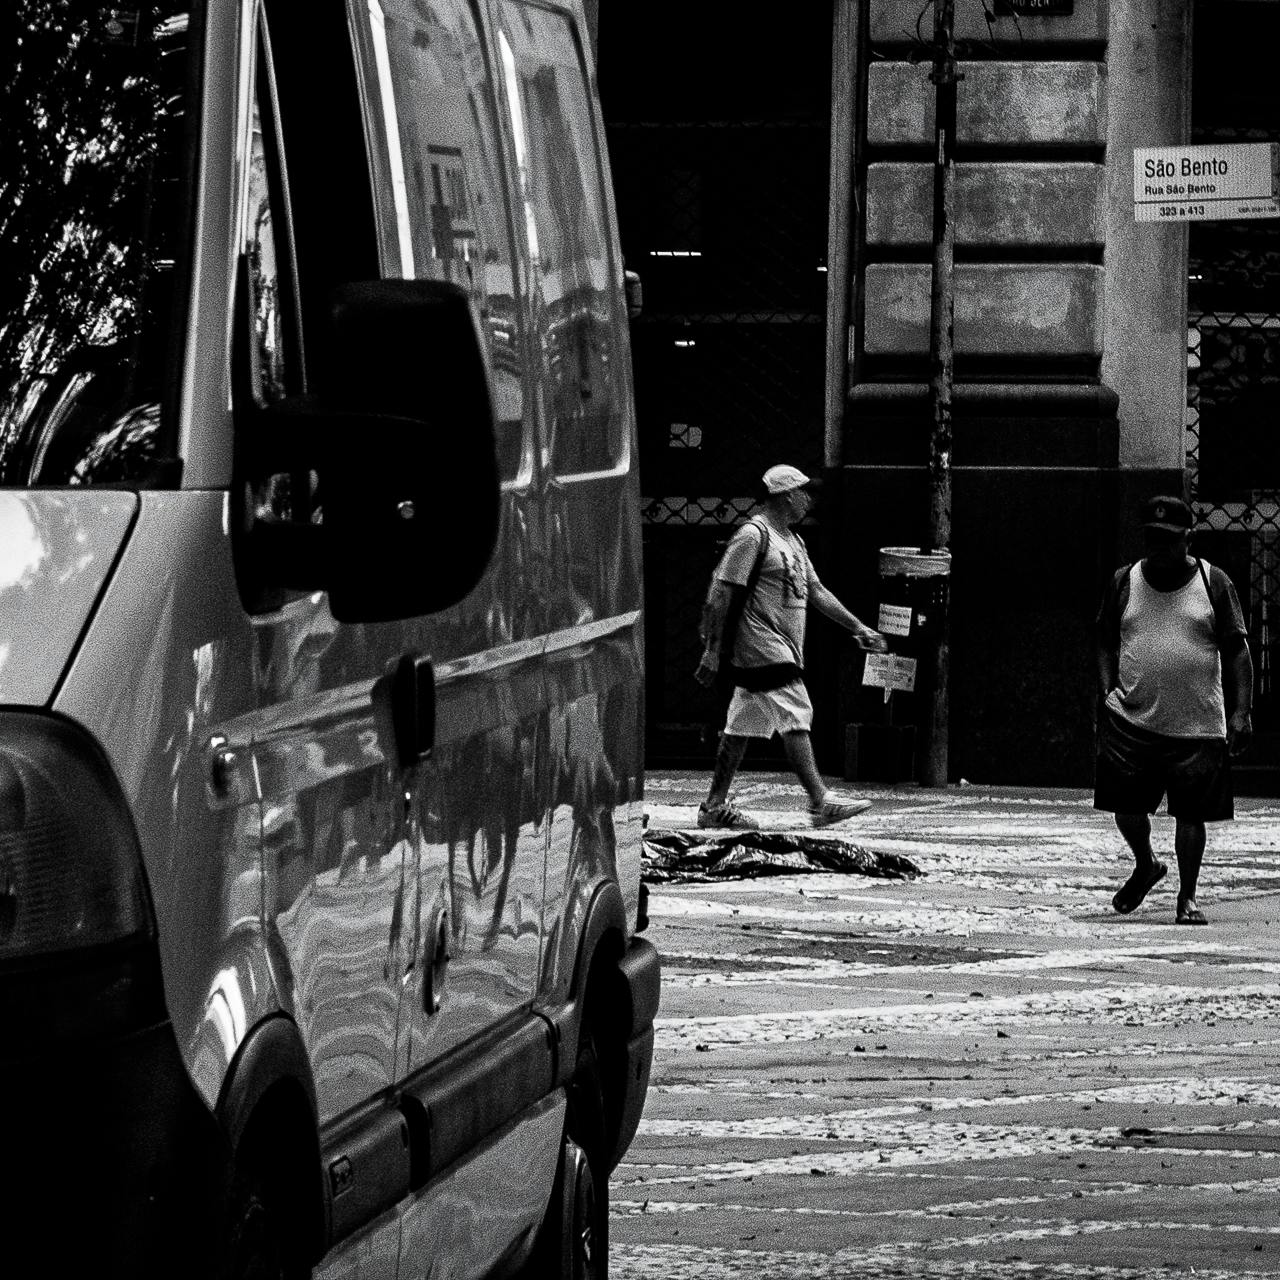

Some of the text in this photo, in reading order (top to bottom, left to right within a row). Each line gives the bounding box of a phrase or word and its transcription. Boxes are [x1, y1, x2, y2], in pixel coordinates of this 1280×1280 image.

[1144, 157, 1228, 178] São Bento
[1144, 183, 1216, 195] Rua São Bento
[1160, 205, 1205, 217] 323 a 413
